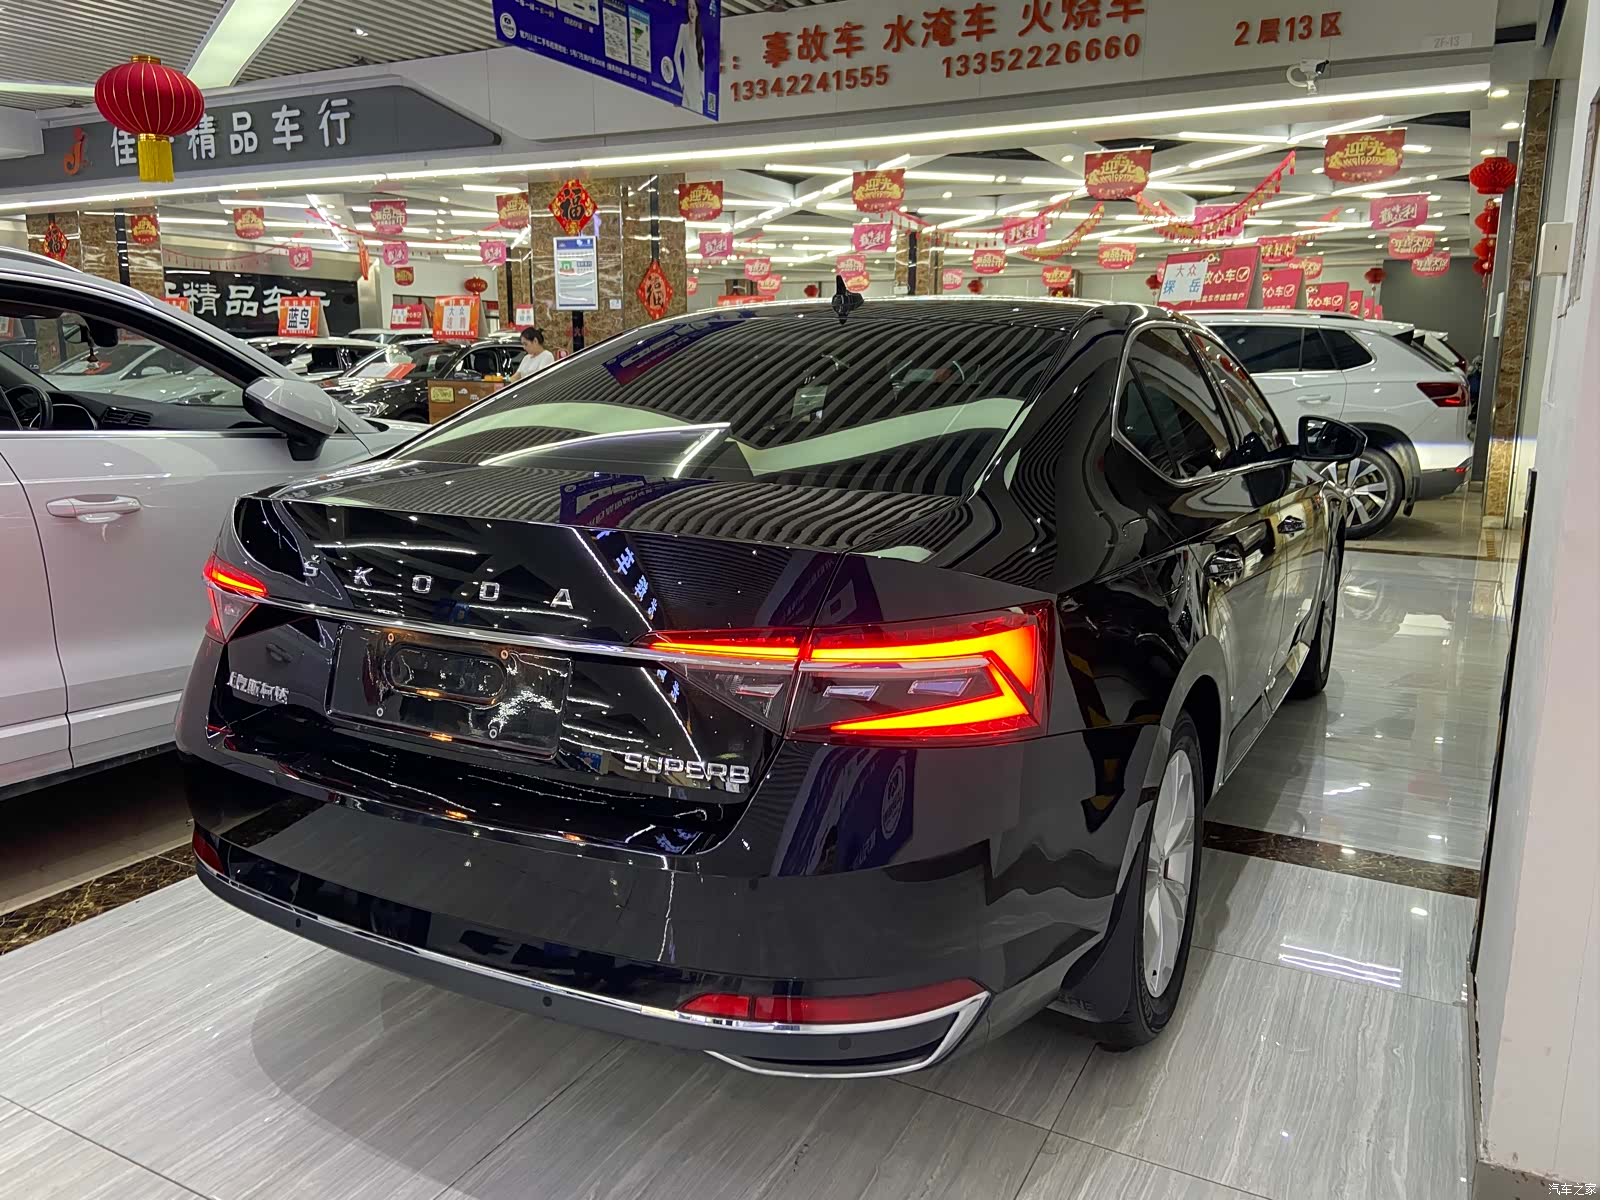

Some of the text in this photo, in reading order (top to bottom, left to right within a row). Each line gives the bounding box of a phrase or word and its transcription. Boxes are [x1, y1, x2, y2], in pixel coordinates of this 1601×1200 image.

[764, 22, 865, 69] 事故车
[884, 3, 997, 54] 水淹车
[1018, 0, 1145, 37] 火烧车
[1235, 12, 1342, 46] 2层13区
[731, 33, 1141, 102] 13342241555 13352226660
[111, 97, 350, 167] 佳精品车行
[560, 188, 586, 221] 福
[1176, 264, 1196, 277] 大众
[288, 307, 310, 328] 蓝鸟
[623, 752, 750, 784] SUPERB
